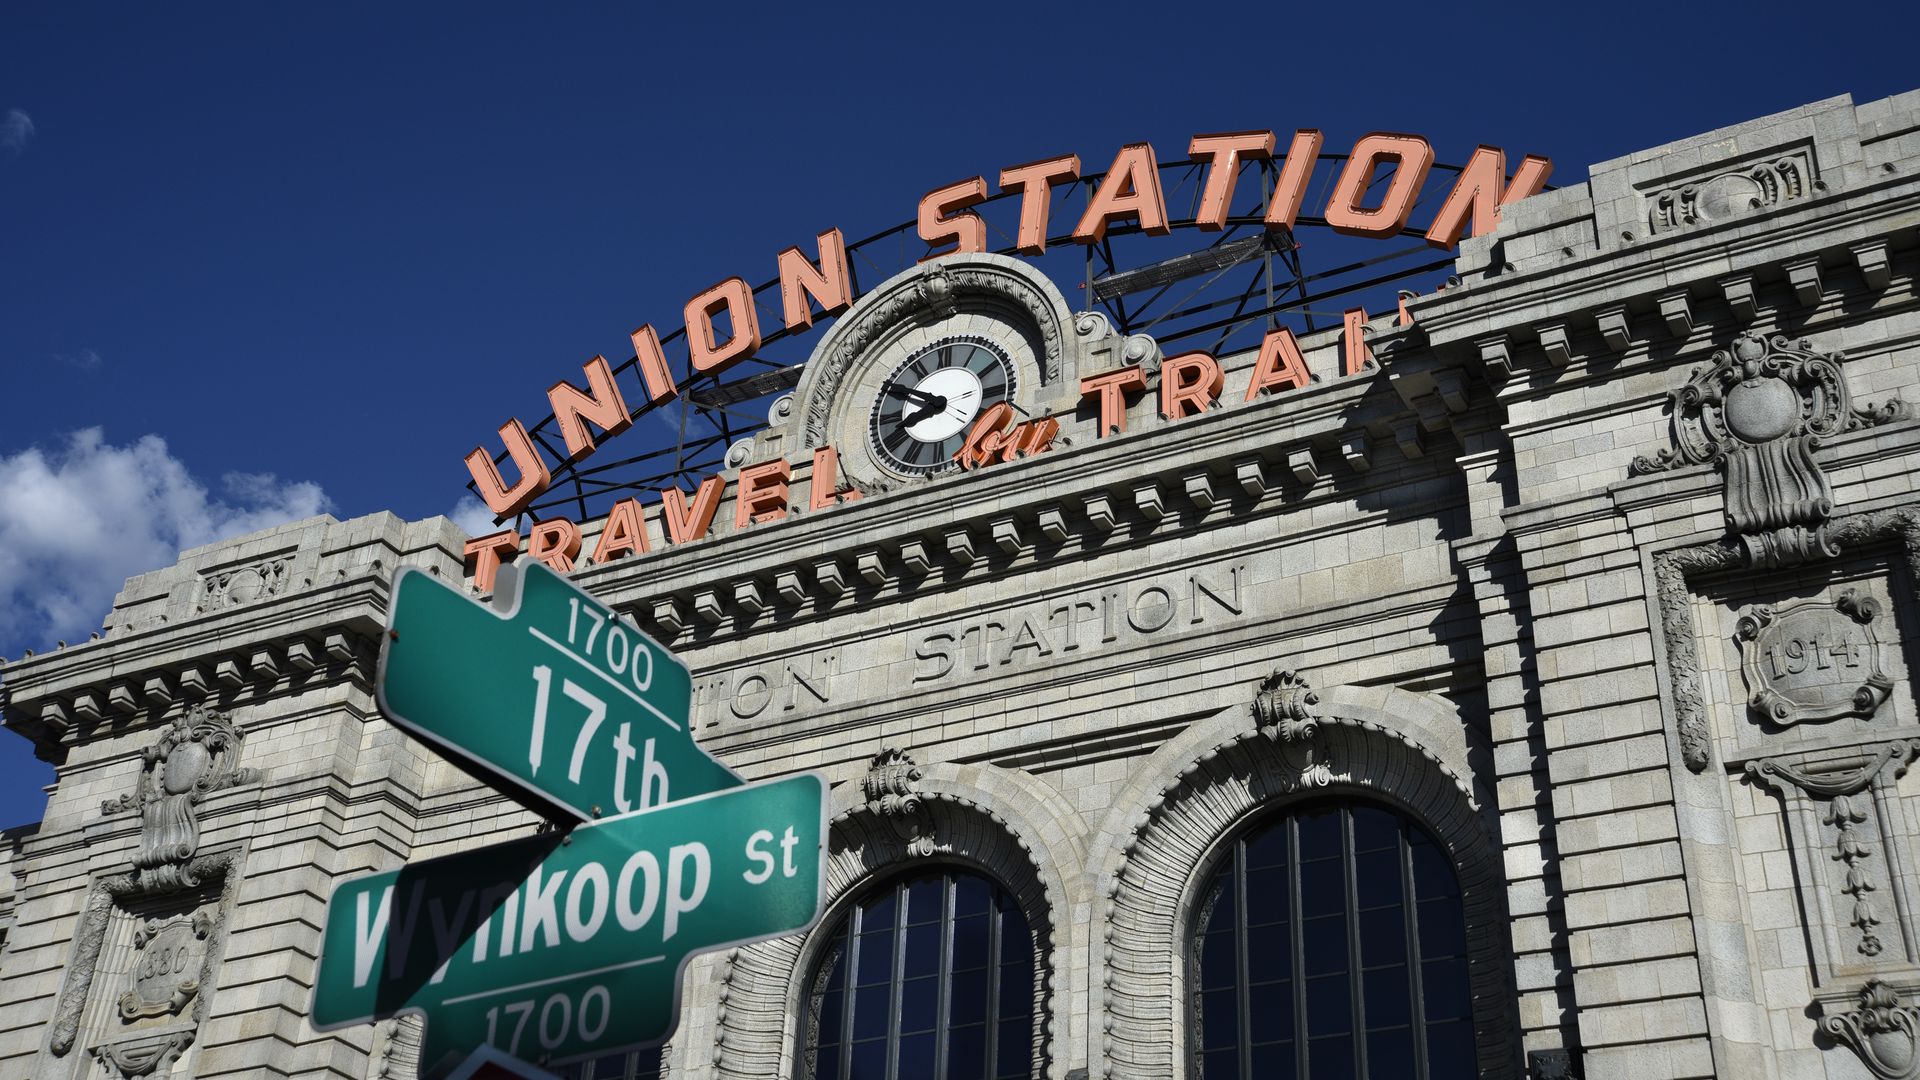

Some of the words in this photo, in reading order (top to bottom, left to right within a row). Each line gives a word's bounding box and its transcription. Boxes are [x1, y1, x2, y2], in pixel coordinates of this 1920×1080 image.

[463, 226, 853, 519] UNION
[917, 128, 1554, 264] STATION
[463, 445, 862, 594] TRAVEL
[1080, 290, 1415, 438] TRAI
[567, 597, 653, 692] 1700
[690, 655, 837, 732] ION
[912, 564, 1246, 684] STATION
[1765, 632, 1859, 681] 1914
[528, 664, 670, 815] 17th
[353, 841, 712, 989] Wynkoop
[742, 823, 800, 885] St
[486, 985, 611, 1056] 1700
